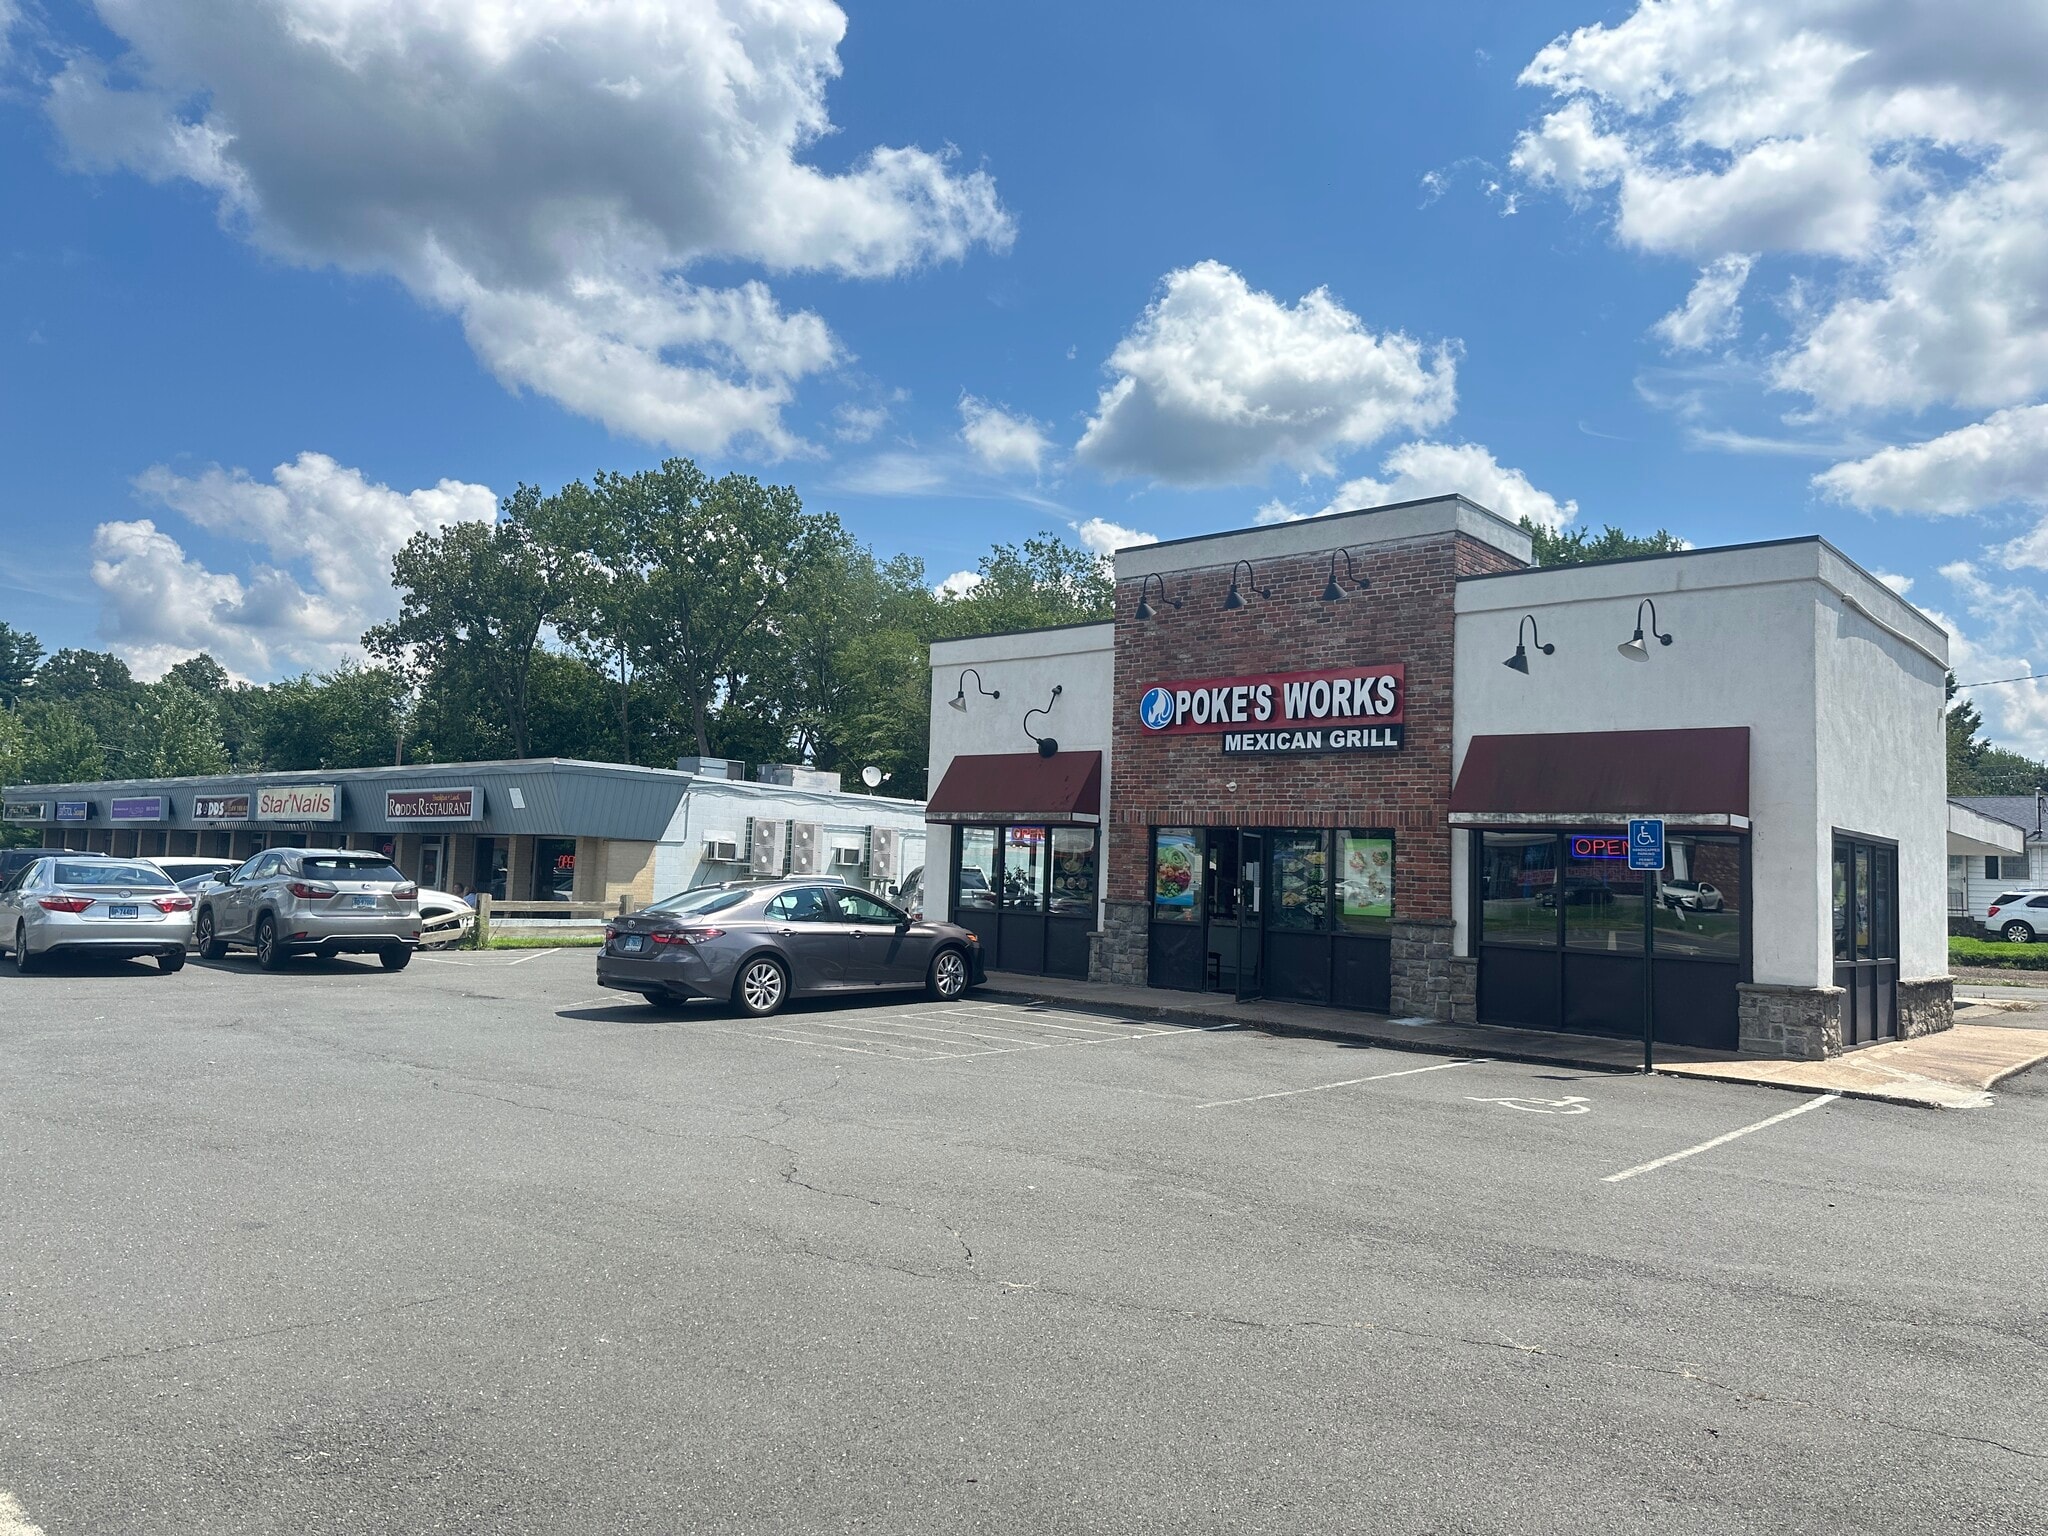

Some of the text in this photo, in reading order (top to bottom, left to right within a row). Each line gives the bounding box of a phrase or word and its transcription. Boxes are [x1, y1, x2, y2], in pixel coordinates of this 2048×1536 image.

[1175, 675, 1396, 725] POKE'S WORKS
[1225, 728, 1398, 752] MEXICAN GRILL
[291, 793, 331, 813] Nails
[418, 798, 471, 816] RESTAURANT
